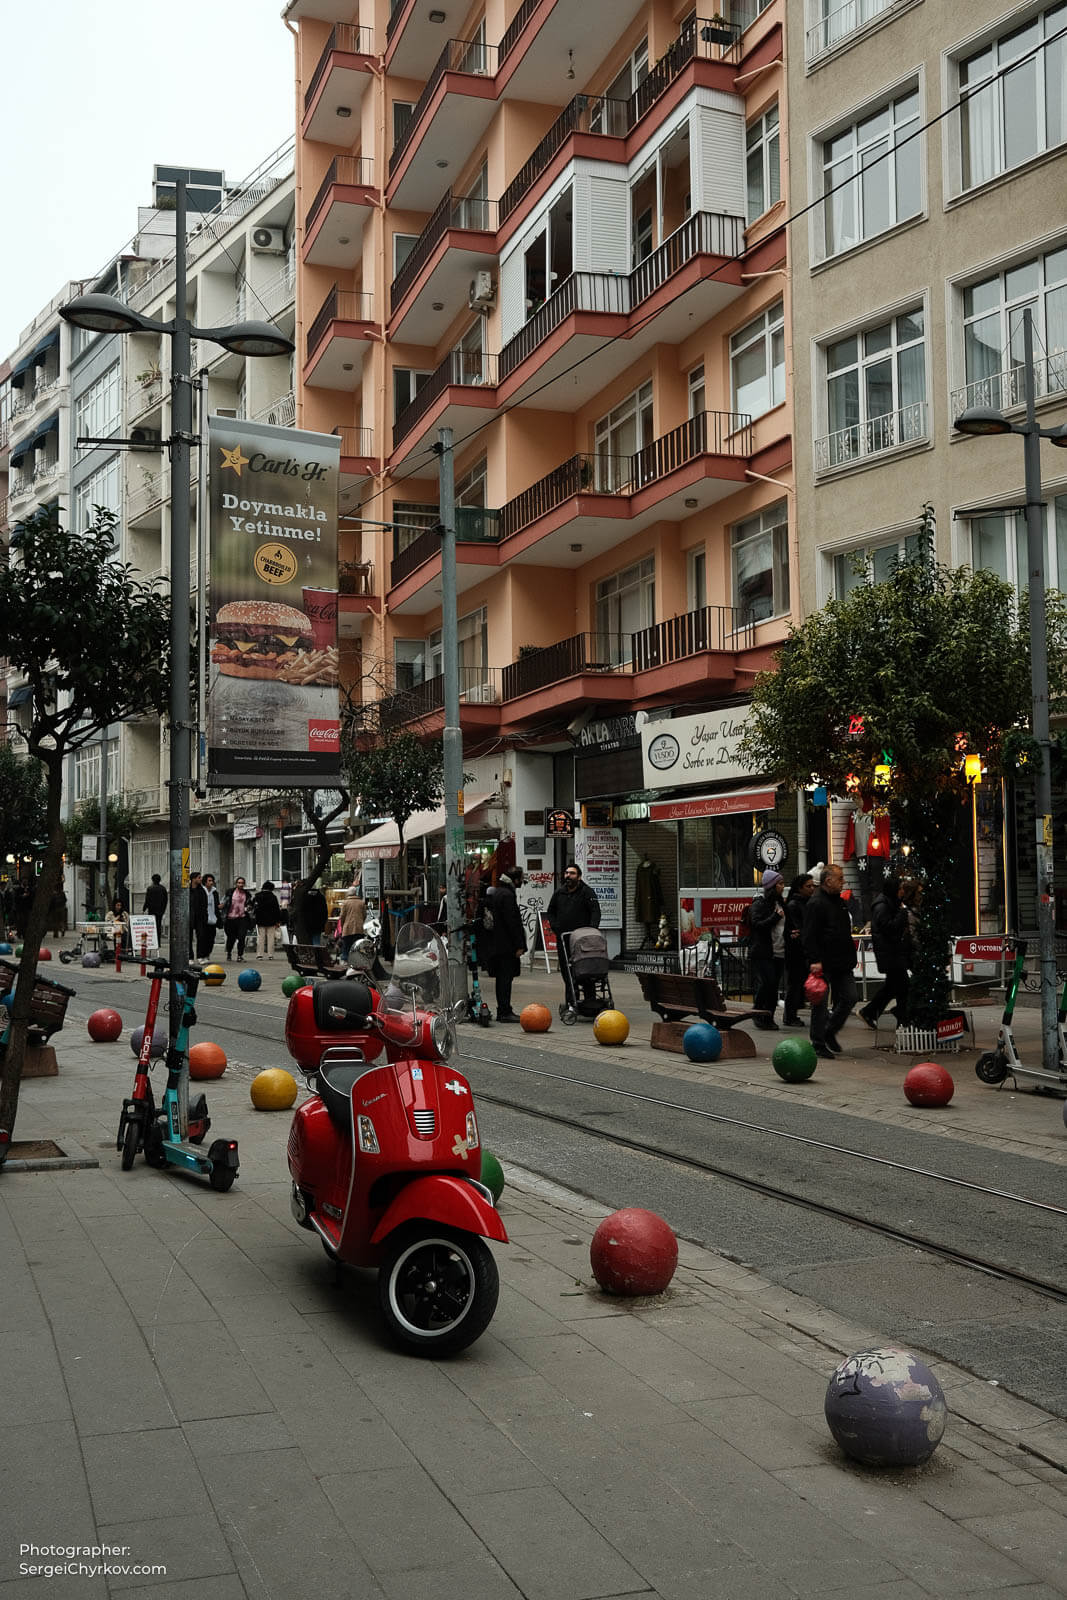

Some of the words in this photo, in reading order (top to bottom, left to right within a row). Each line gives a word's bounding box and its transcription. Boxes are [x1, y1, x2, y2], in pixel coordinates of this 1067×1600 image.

[248, 452, 301, 477] Carl's
[301, 461, 327, 481] Jr.
[222, 493, 328, 522] Doymakla
[229, 516, 321, 542] Yetinme!
[263, 564, 285, 578] BEEF
[309, 727, 340, 739] Coca-Cola
[691, 725, 719, 746] Yaşar
[683, 747, 704, 770] Sorbe
[706, 757, 714, 766] ve
[712, 903, 727, 913] PET
[977, 944, 1010, 953] VICTORINX
[140, 1035, 152, 1061] hop
